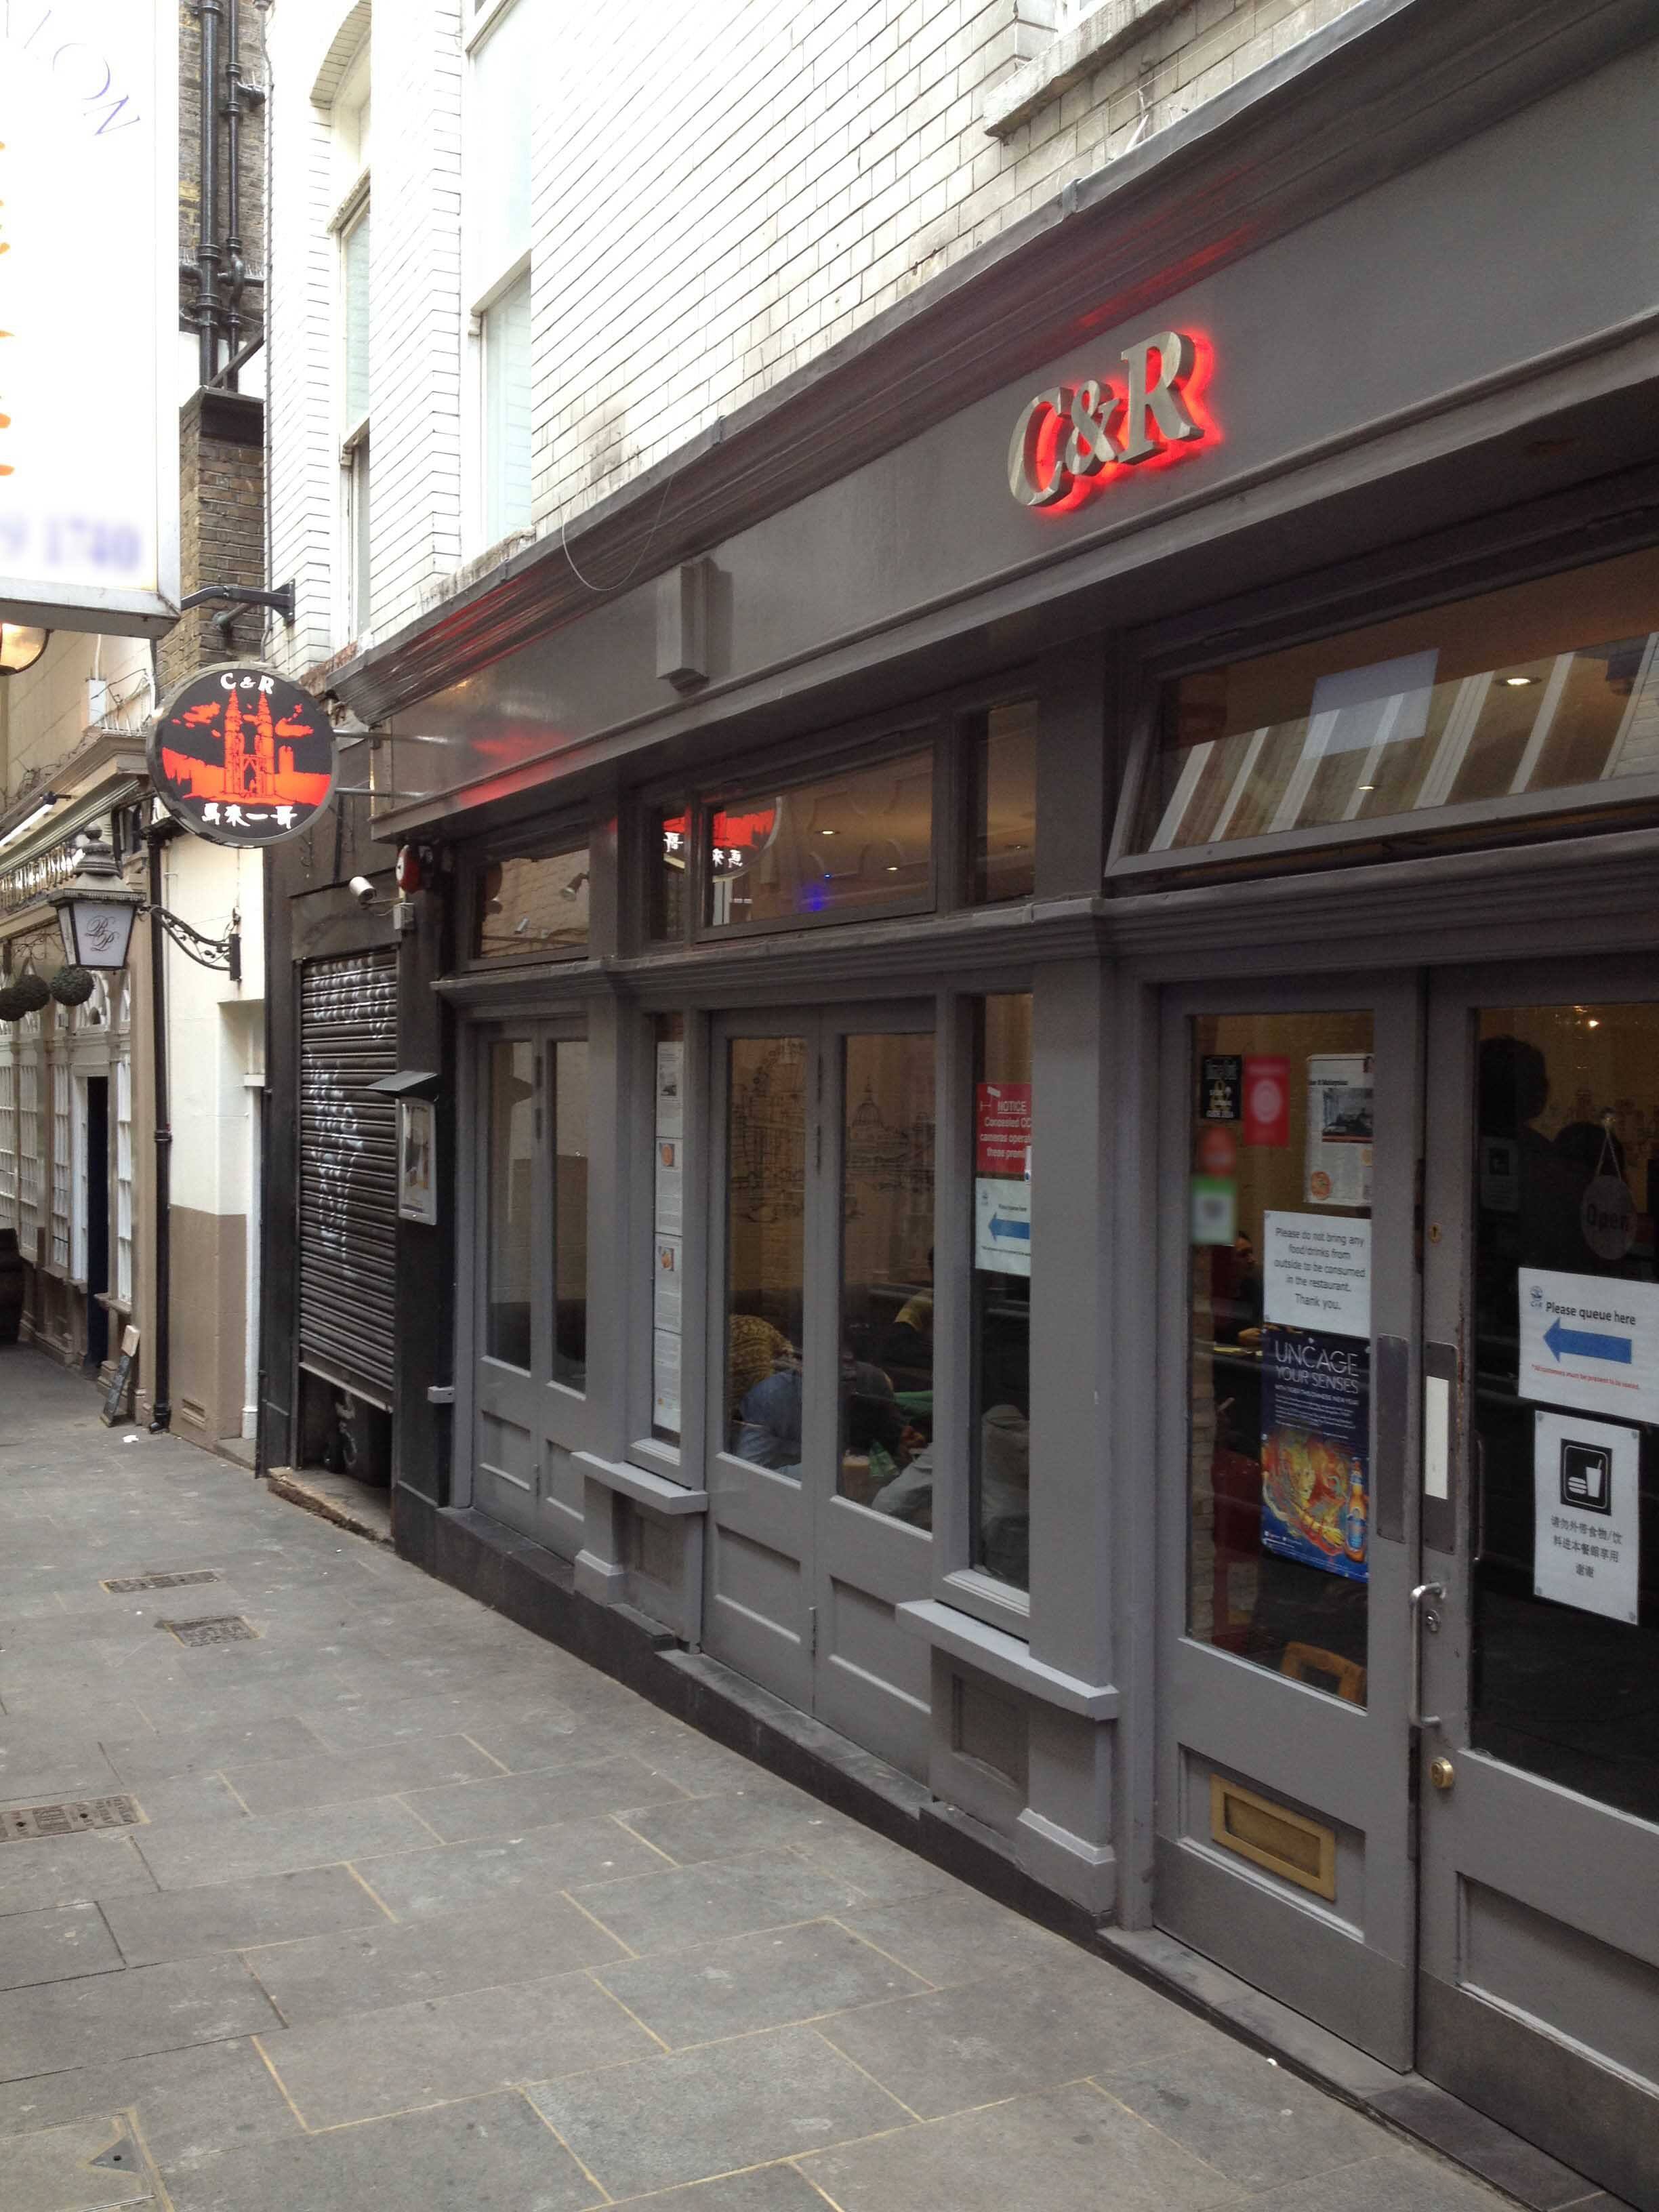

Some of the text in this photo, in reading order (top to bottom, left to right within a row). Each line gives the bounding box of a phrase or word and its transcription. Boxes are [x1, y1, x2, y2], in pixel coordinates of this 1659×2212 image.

[1008, 331, 1205, 507] C&R
[998, 1101, 1027, 1112] NOTICE
[1275, 1227, 1365, 1247] Please do not bring any
[1331, 1248, 1351, 1259] from
[1274, 1258, 1366, 1277] outside to be consumed
[1286, 1274, 1294, 1284] in
[1295, 1275, 1307, 1286] the
[1295, 1293, 1321, 1307] Thank
[1545, 1301, 1636, 1326] Please queue here
[1275, 1340, 1359, 1377] UNCAGE
[1275, 1365, 1359, 1394] YOUR SENSES
